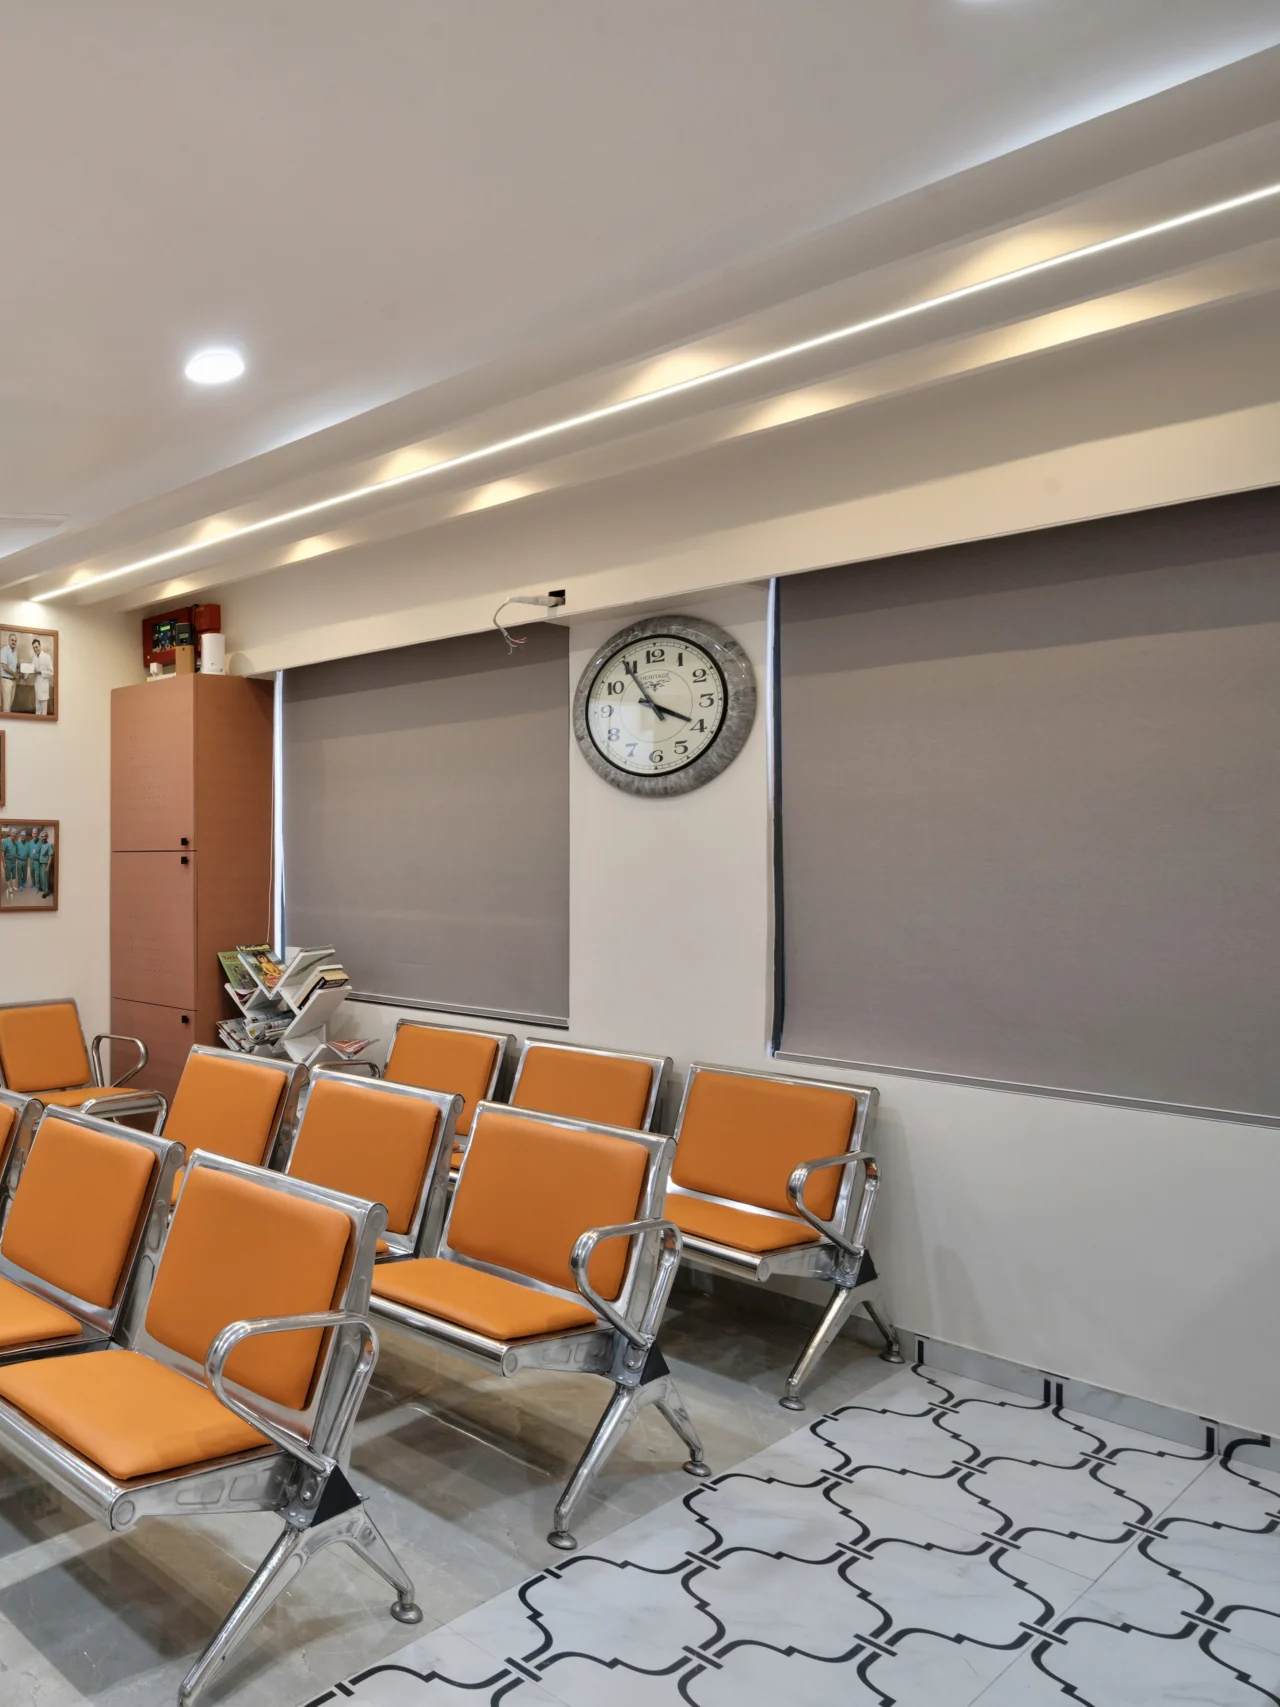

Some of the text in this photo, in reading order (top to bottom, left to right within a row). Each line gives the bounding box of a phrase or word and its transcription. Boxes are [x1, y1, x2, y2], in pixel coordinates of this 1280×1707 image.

[645, 649, 665, 664] 12
[677, 652, 684, 667] 1
[692, 668, 707, 683] 2
[607, 680, 624, 695] 10
[699, 693, 714, 708] 3
[600, 704, 614, 718] 9
[689, 718, 707, 733] 4
[607, 727, 620, 741] 8
[625, 742, 638, 757] 7
[674, 740, 689, 754] 5
[648, 750, 663, 763] 6
